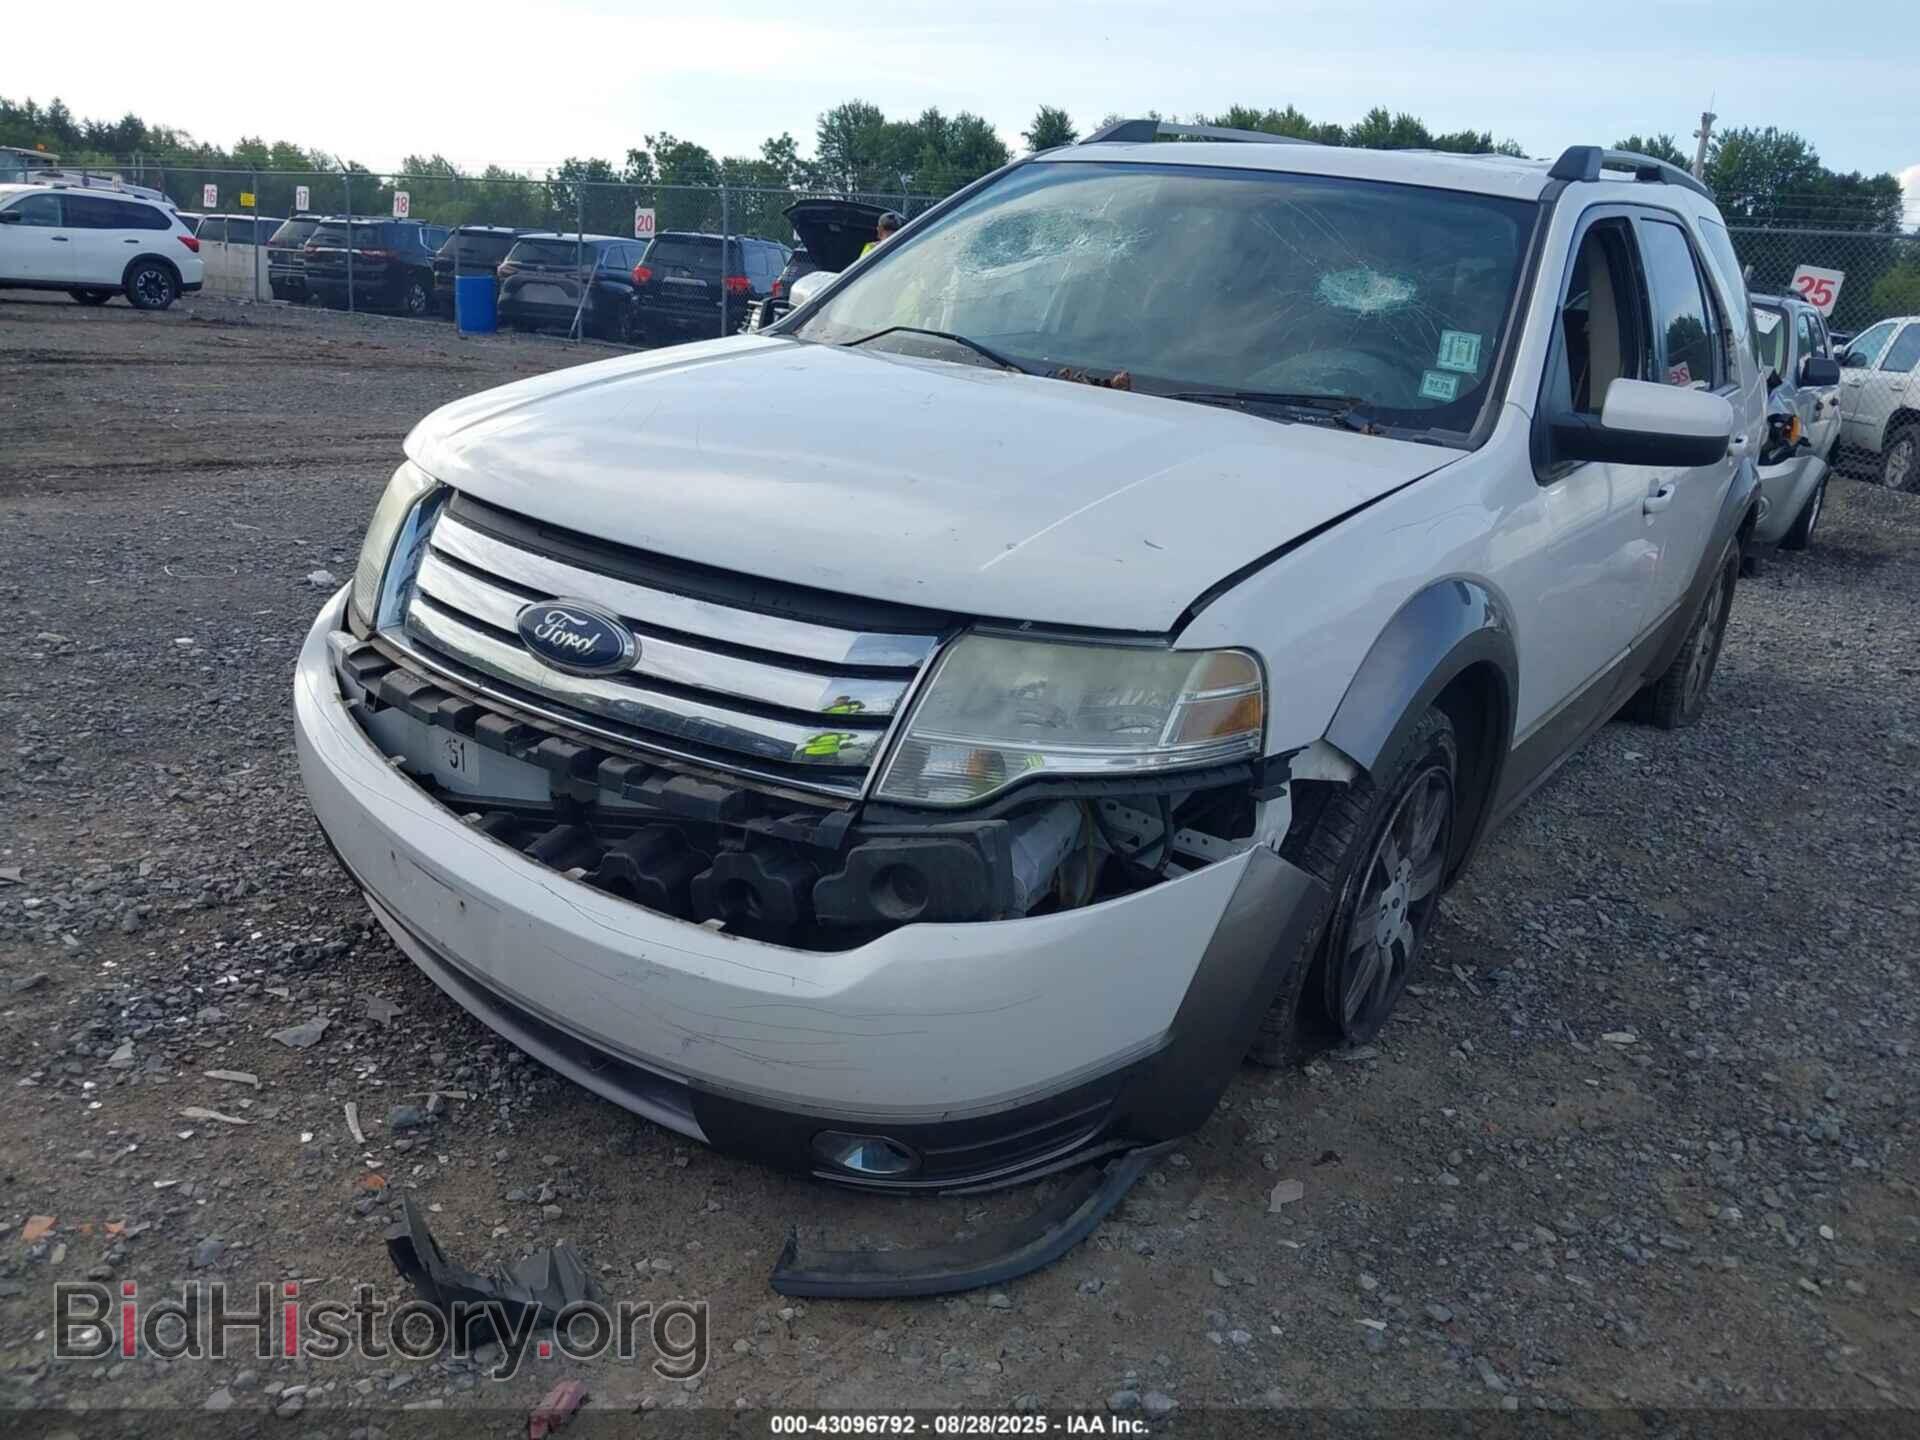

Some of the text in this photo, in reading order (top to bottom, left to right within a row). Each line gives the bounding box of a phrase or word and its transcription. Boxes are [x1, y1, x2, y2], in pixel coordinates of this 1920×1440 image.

[396, 196, 408, 213] 18
[637, 214, 653, 232] 20
[1797, 275, 1836, 307] 25
[534, 609, 602, 656] Ford
